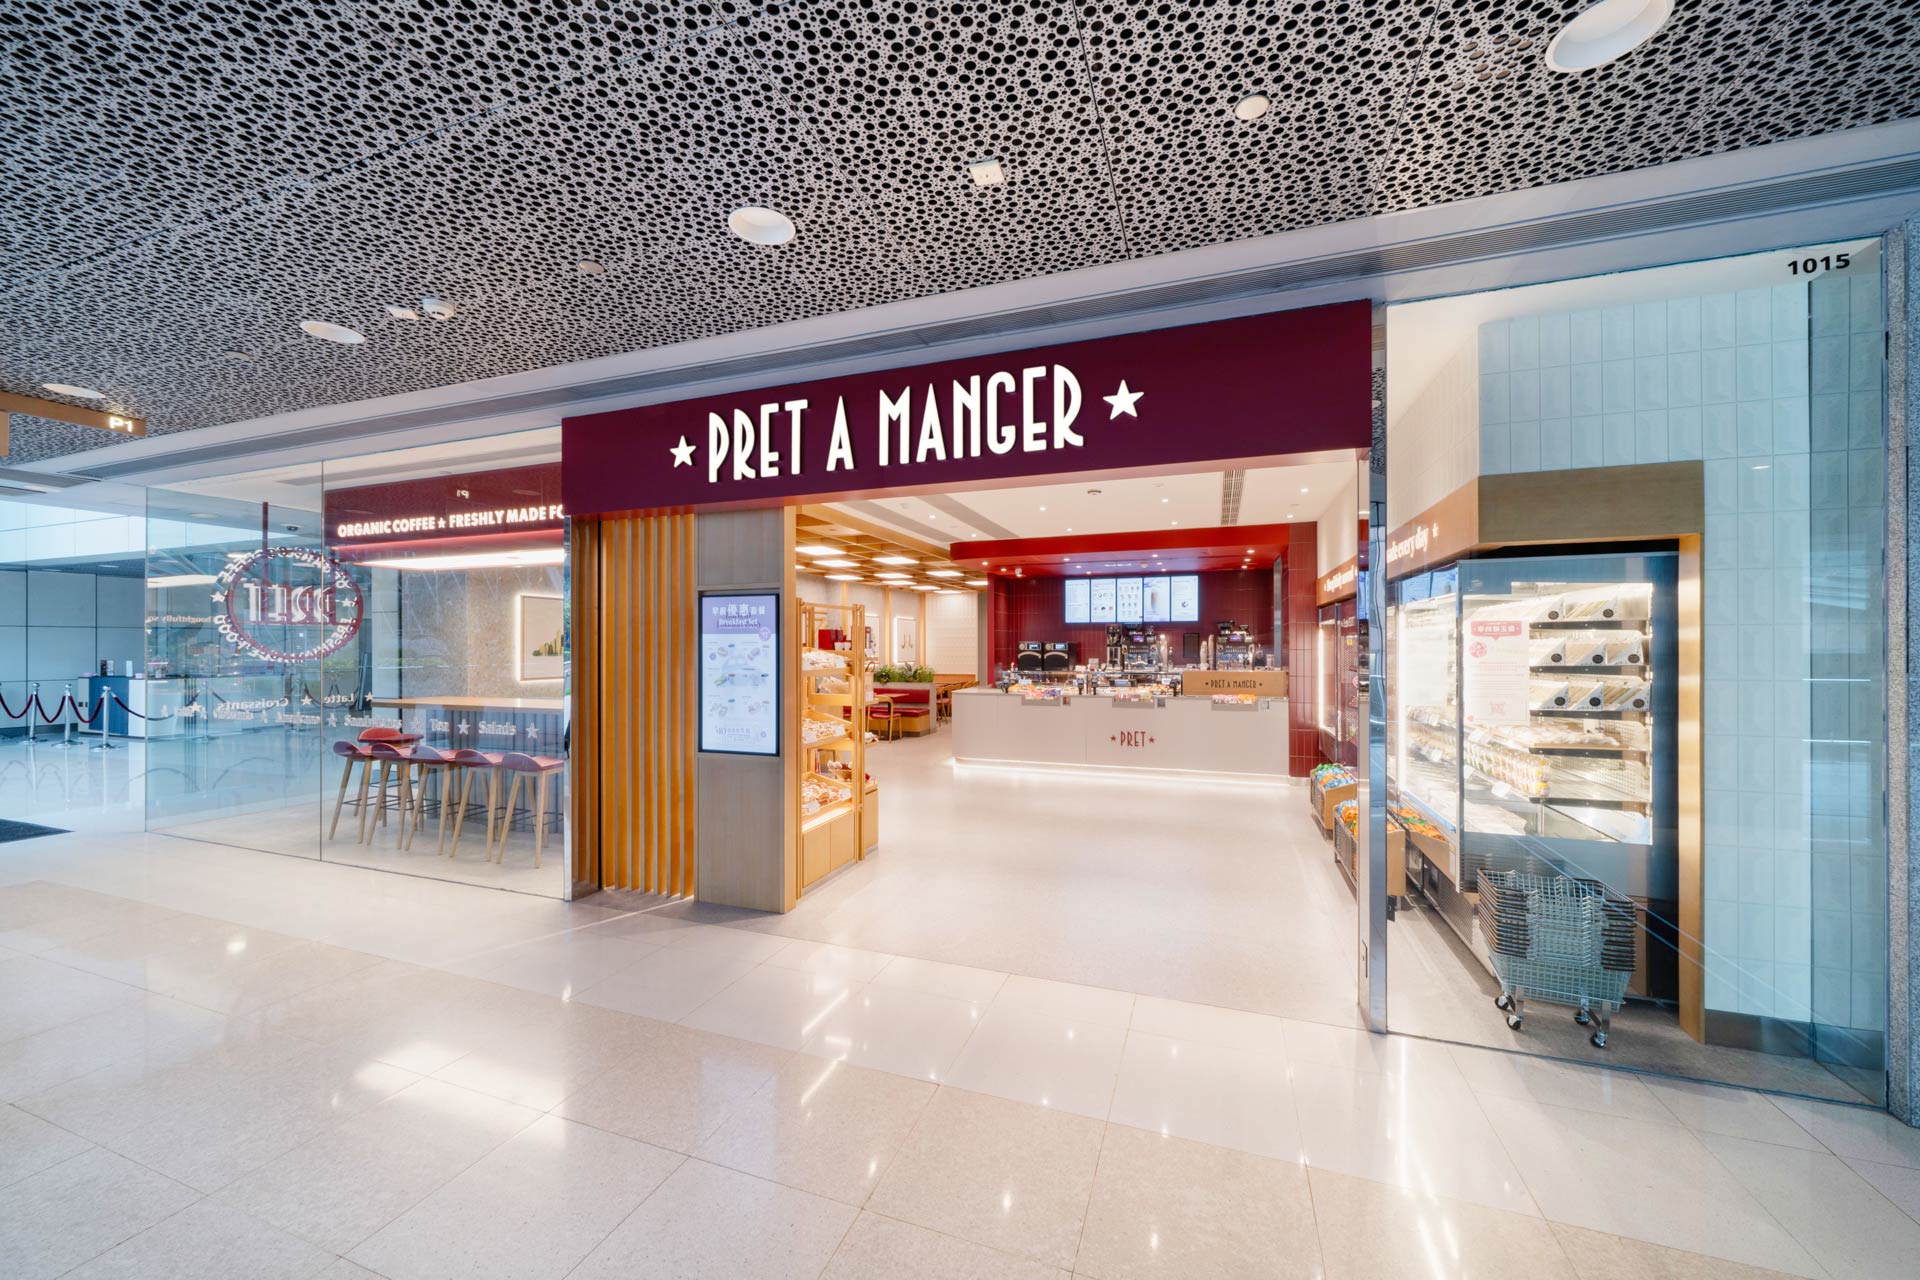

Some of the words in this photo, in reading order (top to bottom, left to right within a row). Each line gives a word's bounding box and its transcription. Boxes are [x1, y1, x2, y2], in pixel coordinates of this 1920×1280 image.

[1787, 253, 1850, 275] 1015
[110, 417, 132, 432] P1
[708, 399, 808, 483] PRET
[826, 395, 855, 471] A
[878, 364, 1084, 467] MANGER
[337, 520, 391, 538] ORGANIC
[392, 516, 436, 532] COFFEE
[449, 509, 505, 528] FRESHLY
[506, 505, 546, 523] MADE
[1210, 679, 1225, 688] PRET
[1227, 680, 1231, 688] A
[1232, 680, 1257, 689] MANGER
[478, 720, 517, 736] Salads
[1120, 731, 1147, 747] PRET
